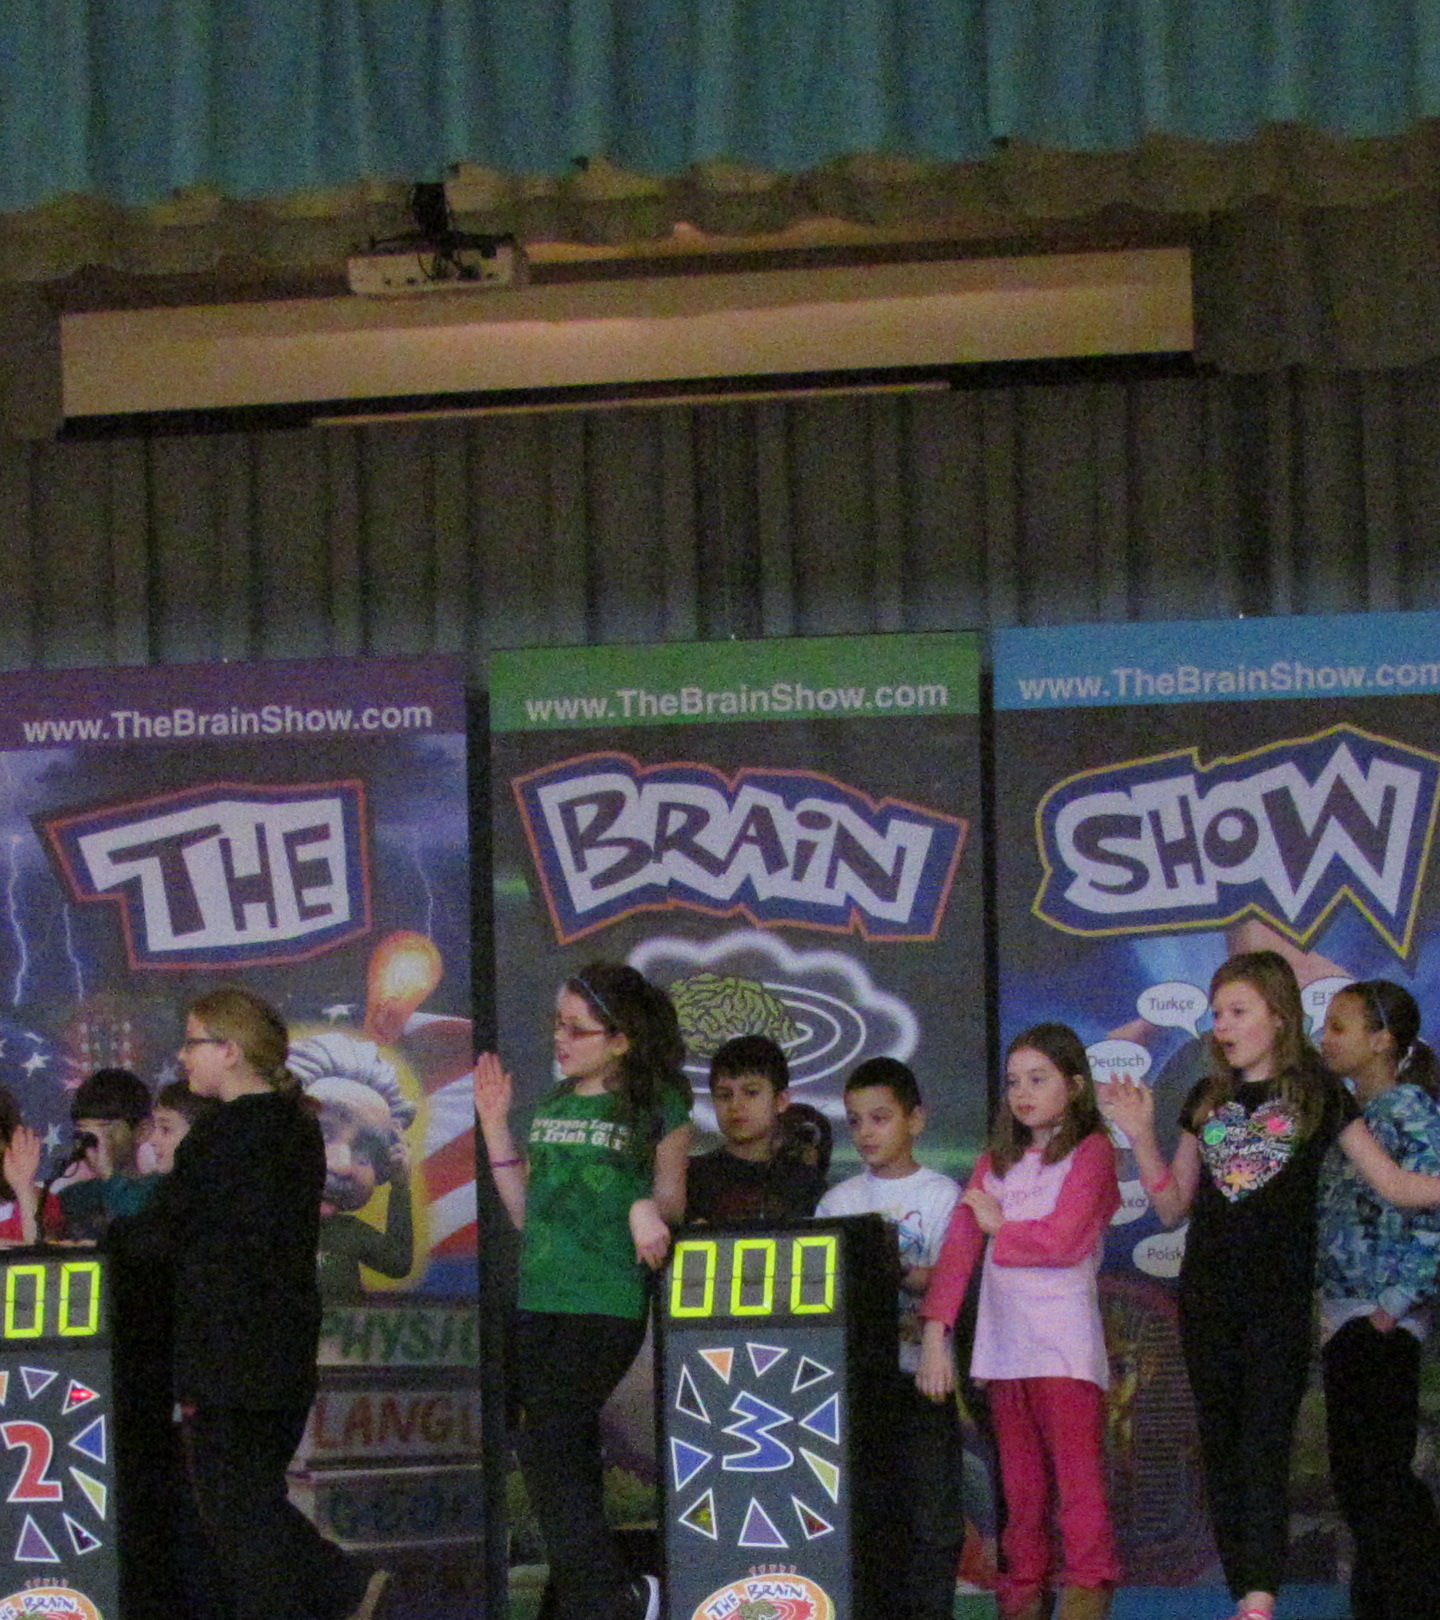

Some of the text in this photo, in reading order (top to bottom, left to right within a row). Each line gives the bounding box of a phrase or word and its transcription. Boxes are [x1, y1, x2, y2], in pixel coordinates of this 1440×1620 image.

[22, 703, 433, 743] www.TheBrainShow.com
[525, 682, 948, 723] www.TheBrainShow.com
[1071, 764, 1396, 900] SHOW
[108, 823, 332, 935] THE
[1087, 1054, 1145, 1069] Deutsch
[0, 1420, 64, 1502] 2
[721, 1390, 794, 1471] 3
[707, 1592, 740, 1618] THE
